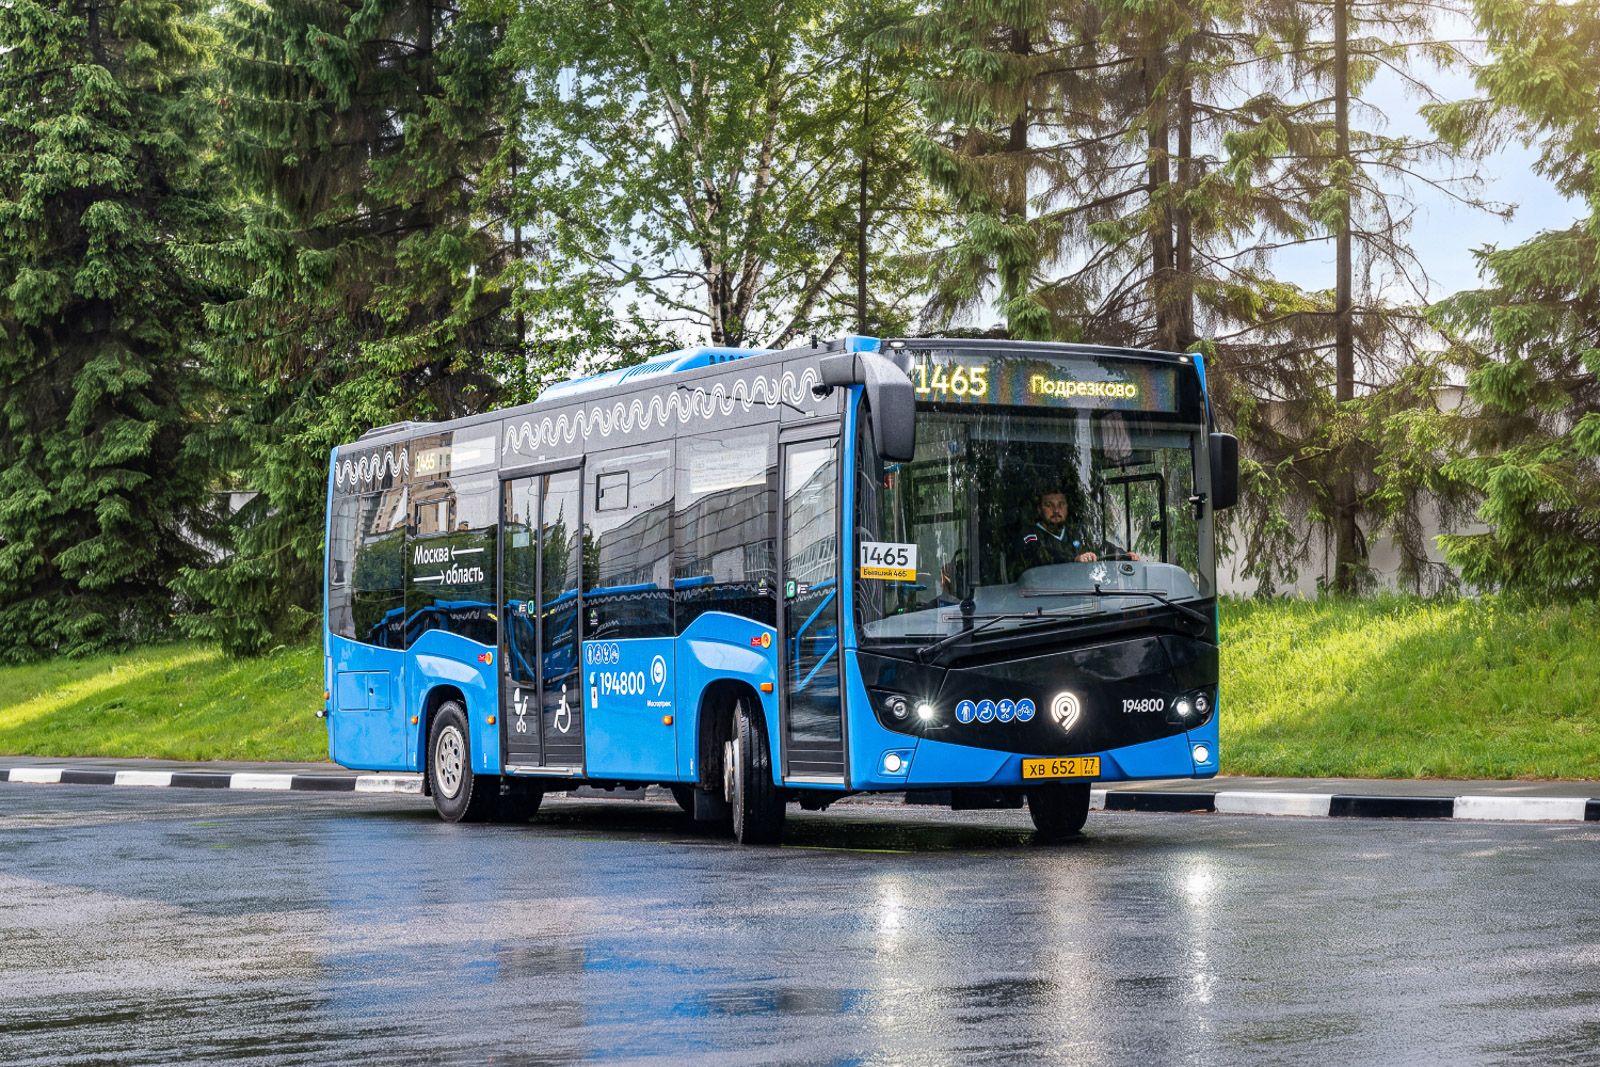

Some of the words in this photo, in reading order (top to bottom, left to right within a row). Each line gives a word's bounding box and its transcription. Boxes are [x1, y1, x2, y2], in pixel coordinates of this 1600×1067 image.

[914, 363, 988, 395] 1465
[1030, 374, 1137, 397] Подрезково
[416, 453, 435, 473] 1465
[413, 545, 449, 565] Москва
[862, 546, 908, 566] 1465
[446, 563, 484, 584] область
[863, 568, 892, 577] Бывший
[600, 671, 645, 695] 194800
[1122, 698, 1164, 712] 194800
[1051, 760, 1075, 775] 652
[1083, 758, 1095, 769] 77
